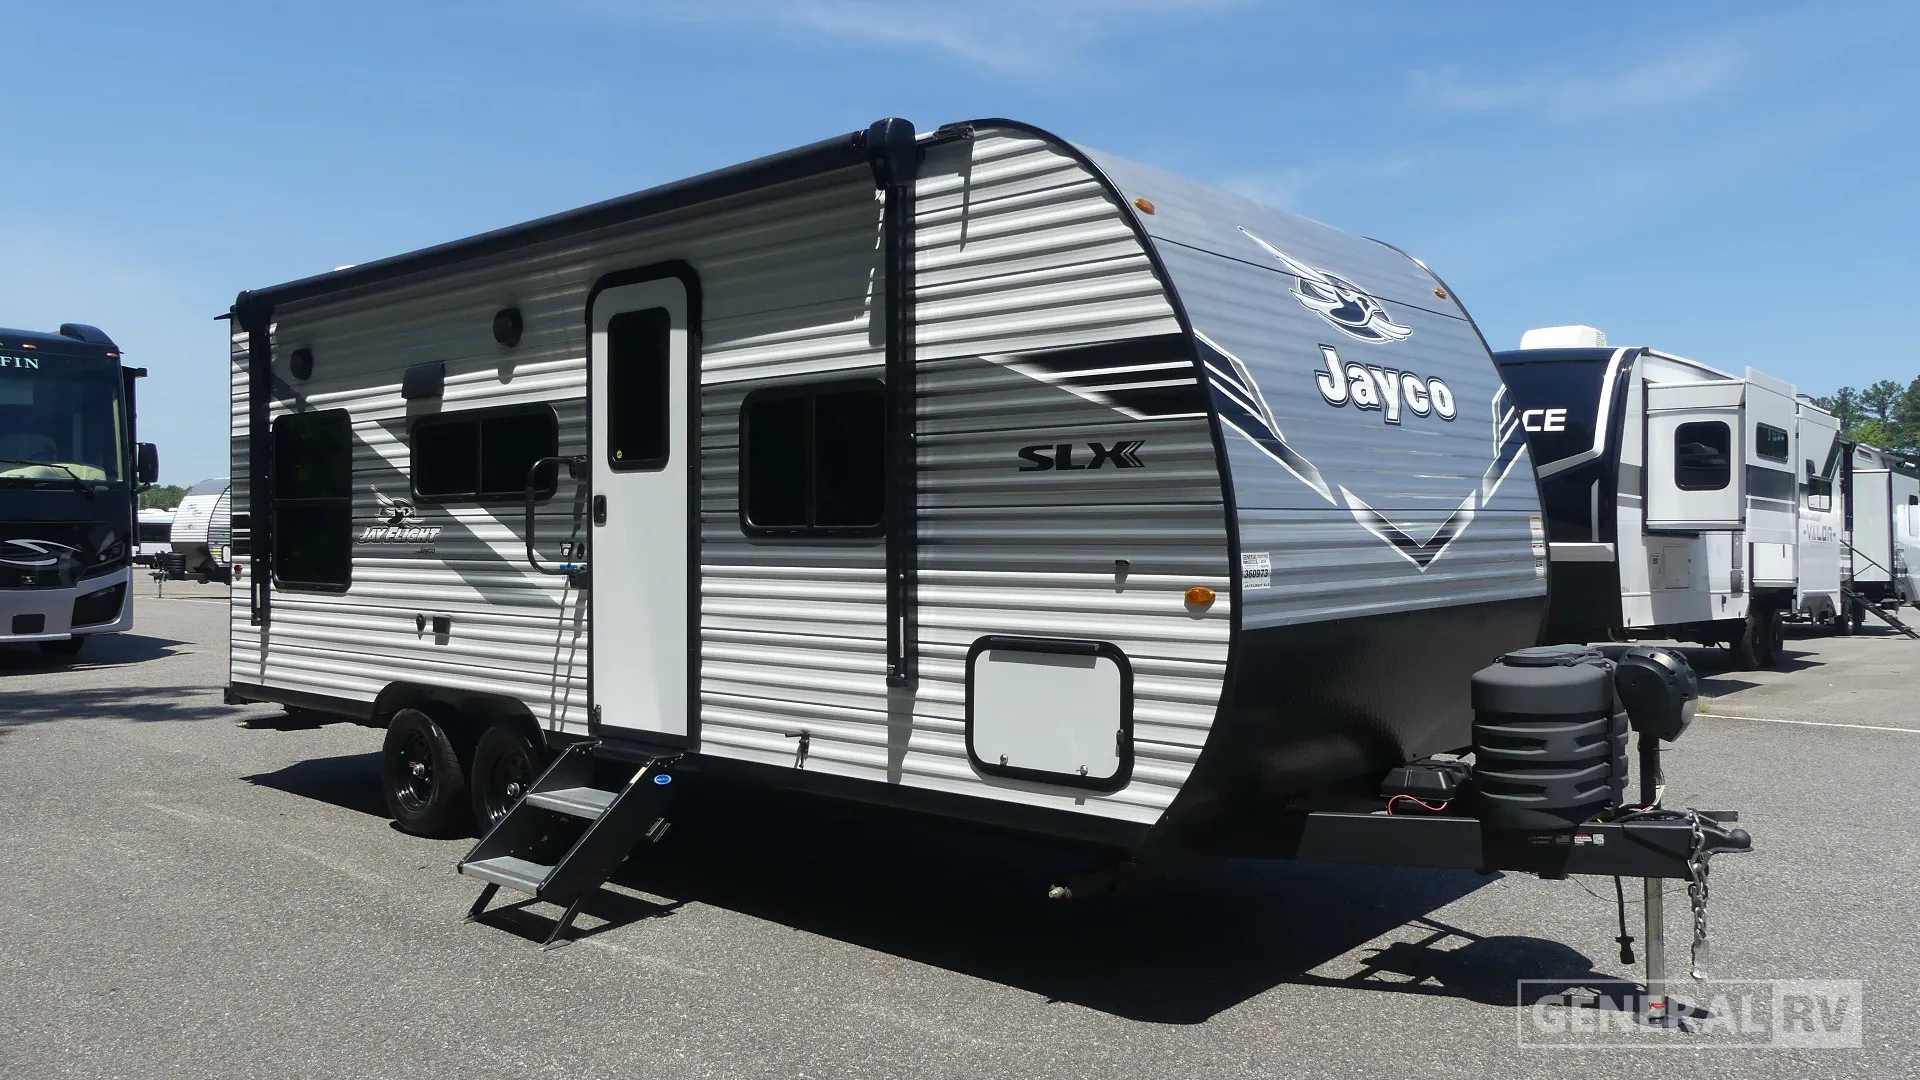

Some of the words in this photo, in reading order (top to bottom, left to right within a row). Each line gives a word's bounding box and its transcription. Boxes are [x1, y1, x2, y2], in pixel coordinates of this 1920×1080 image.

[1314, 343, 1457, 426] Jayco
[1018, 440, 1146, 472] SLX
[358, 526, 388, 545] JAY
[384, 525, 442, 544] FLIGHT
[1244, 569, 1268, 578] 360973
